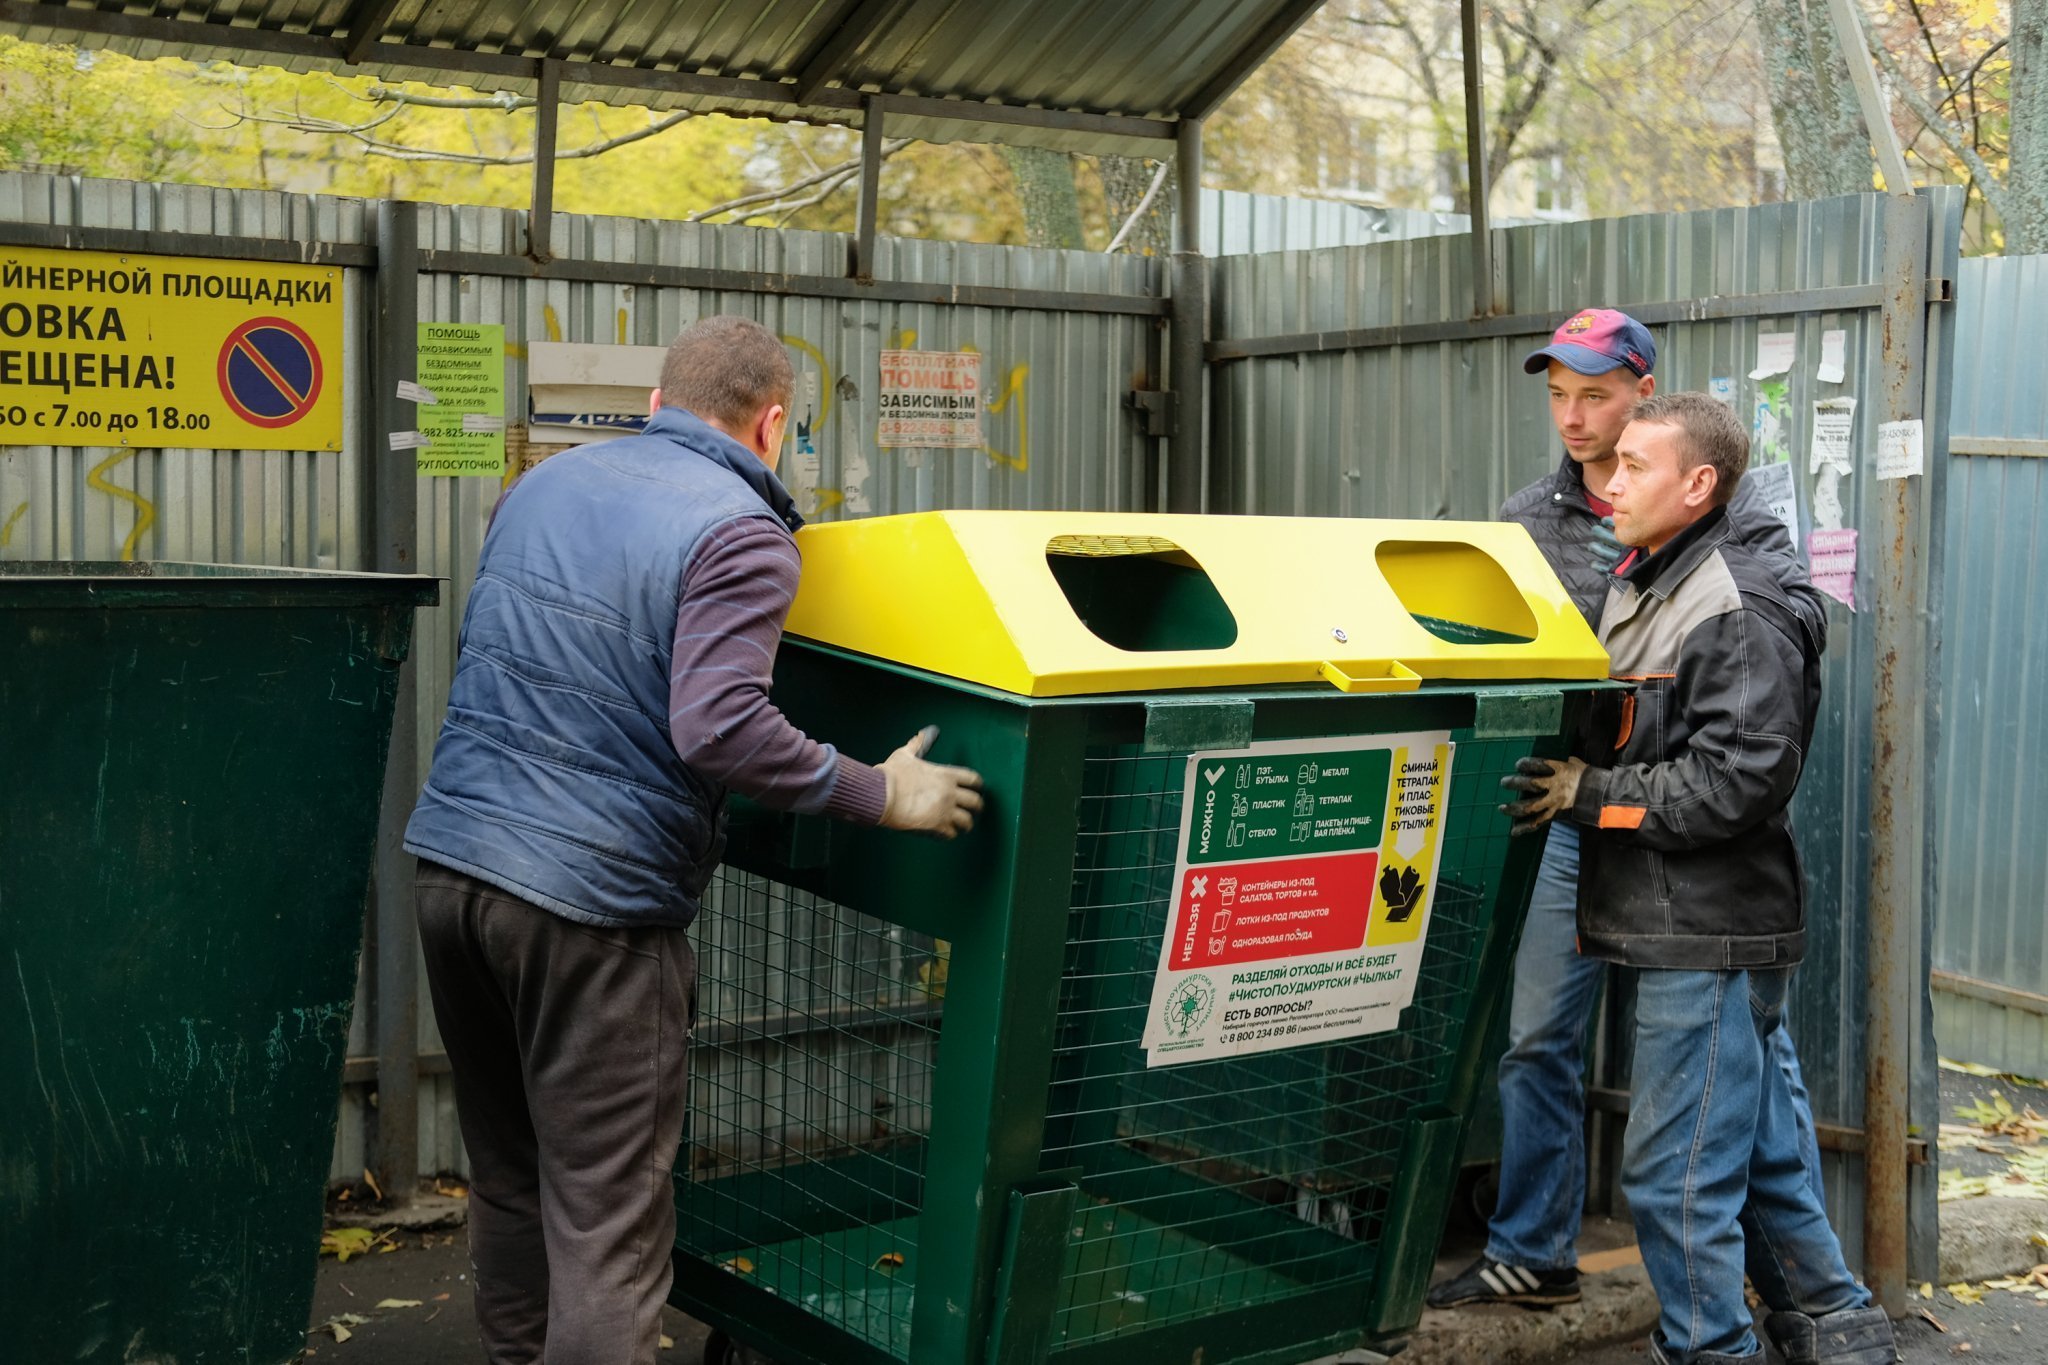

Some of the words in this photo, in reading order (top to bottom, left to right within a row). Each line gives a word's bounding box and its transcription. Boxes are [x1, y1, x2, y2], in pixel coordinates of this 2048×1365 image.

[163, 273, 331, 307] ПЛОЩАДКИ
[0, 302, 127, 341] ОВКА
[427, 328, 480, 340] ПОМОЩЬ
[426, 359, 482, 369] БЕЗДОМНЫМ
[0, 350, 175, 395] ЕЩЕНА!
[53, 404, 101, 428] 7.00
[107, 414, 139, 432] до
[147, 406, 210, 431] 18.00
[1257, 766, 1274, 775] ПЭТ-
[1322, 767, 1350, 777] МЕТАЛЛ
[1401, 759, 1439, 773] СМИНАЙ
[1255, 775, 1289, 785] БУТЫЛКА
[1397, 775, 1440, 788] ТЕТРАПАК
[1319, 794, 1353, 805] ТЕТРАПАК
[1398, 792, 1405, 802] И
[1406, 790, 1434, 801] ПЛАС-
[1252, 799, 1286, 810] ПЛАСТИК
[1394, 804, 1435, 817] ТИКОВЫЕ
[1199, 790, 1216, 854] МОЖНО
[1315, 819, 1343, 828] ПАКЕТЫ
[1350, 816, 1373, 826] ПИЩЕ-
[1390, 818, 1435, 831] БУТЫЛКИ!
[1248, 828, 1277, 838] СТЕКЛО
[1314, 829, 1328, 838] ВАЯ
[1241, 880, 1287, 892] КОНТЕЙНЕРЫ
[1288, 877, 1315, 888] ИЗ-ПОД
[1239, 893, 1274, 904] САЛАТОВ,
[1275, 890, 1302, 899] ТОРТОВ
[1235, 915, 1261, 926] ЛОТКИ
[1261, 912, 1287, 922] ИЗ-ПОД
[1288, 907, 1330, 920] ПРОДУКТОВ
[1181, 903, 1201, 962] НЕЛЬЗЯ
[1231, 935, 1284, 949] ОДНОРАЗОВАЯ
[1284, 930, 1313, 941] ПОСУДА
[1232, 965, 1288, 985] РАЗДЕЛЯЙ
[1289, 962, 1334, 978] ОТХОДЫ
[1335, 961, 1343, 971] И
[1345, 955, 1365, 970] ВСЁ
[1366, 953, 1397, 967] БУДЕТ
[1224, 1009, 1251, 1022] ЕСТЬ
[1253, 1000, 1313, 1018] ВОПРОСЫ?
[1325, 1008, 1338, 1016] ООО
[1229, 1033, 1236, 1043] 8
[1236, 1031, 1255, 1042] 800
[1256, 1028, 1273, 1039] 234
[1273, 1026, 1285, 1036] 89
[1286, 1024, 1298, 1034] 86
